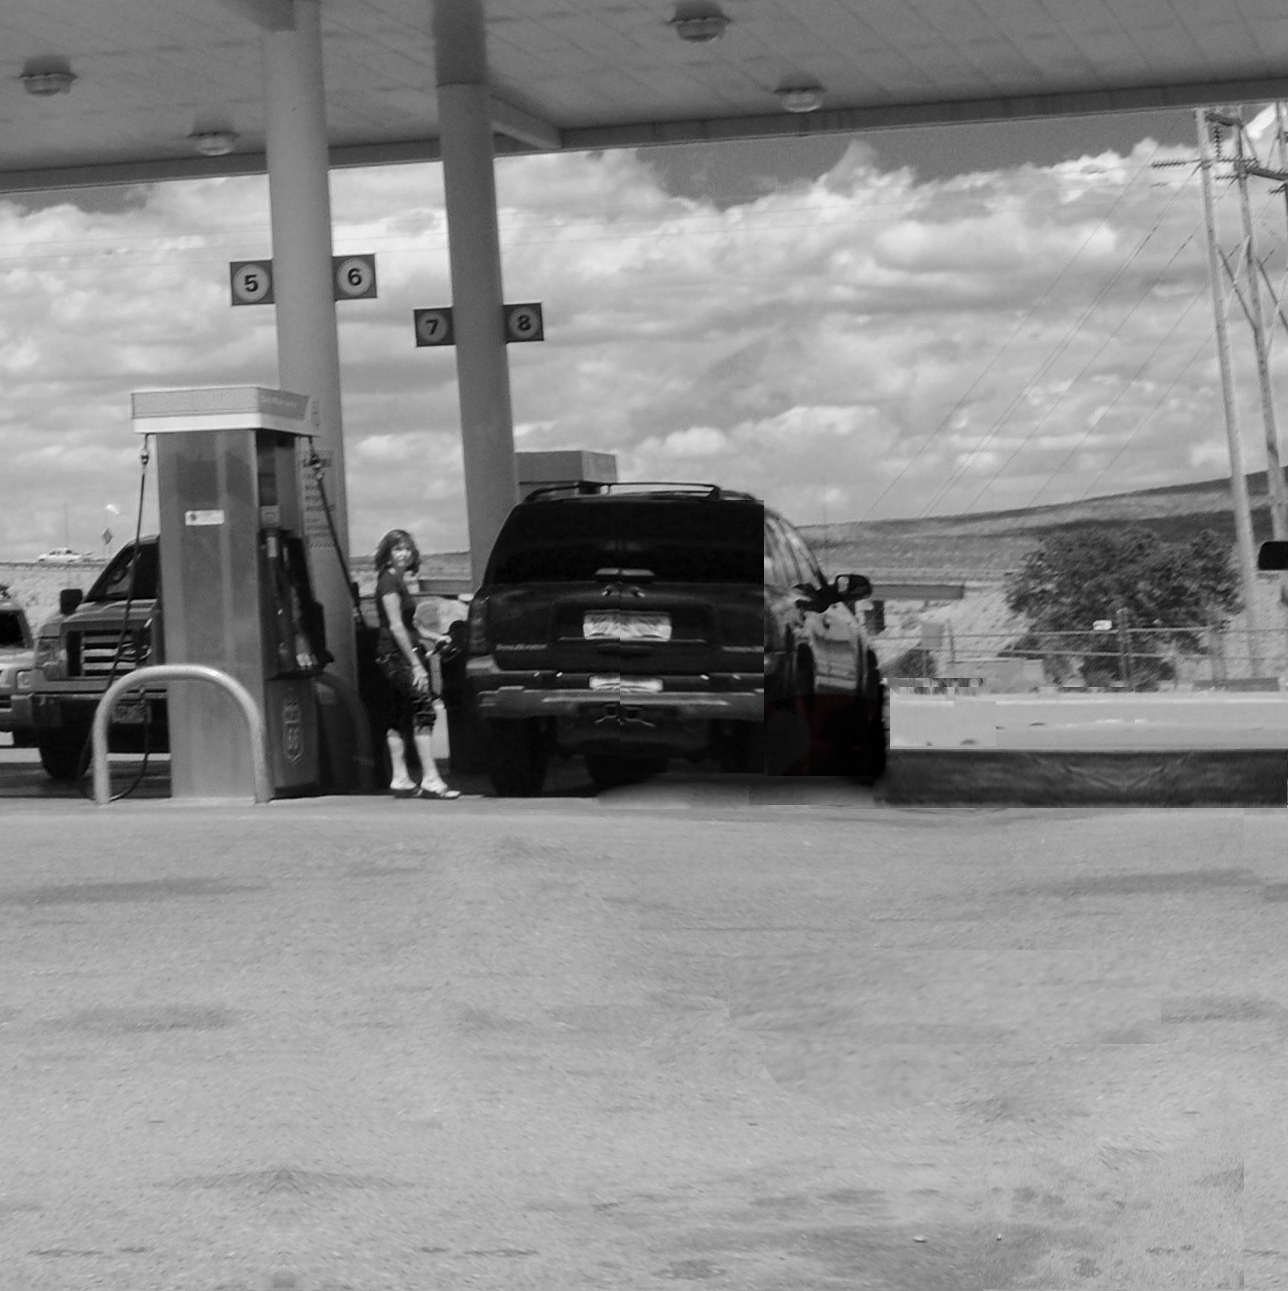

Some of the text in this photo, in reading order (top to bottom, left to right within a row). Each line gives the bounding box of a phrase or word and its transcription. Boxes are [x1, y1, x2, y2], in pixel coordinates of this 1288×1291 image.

[244, 274, 259, 293] 5
[347, 268, 362, 286] 6
[425, 319, 439, 335] 7
[517, 314, 532, 331] 8
